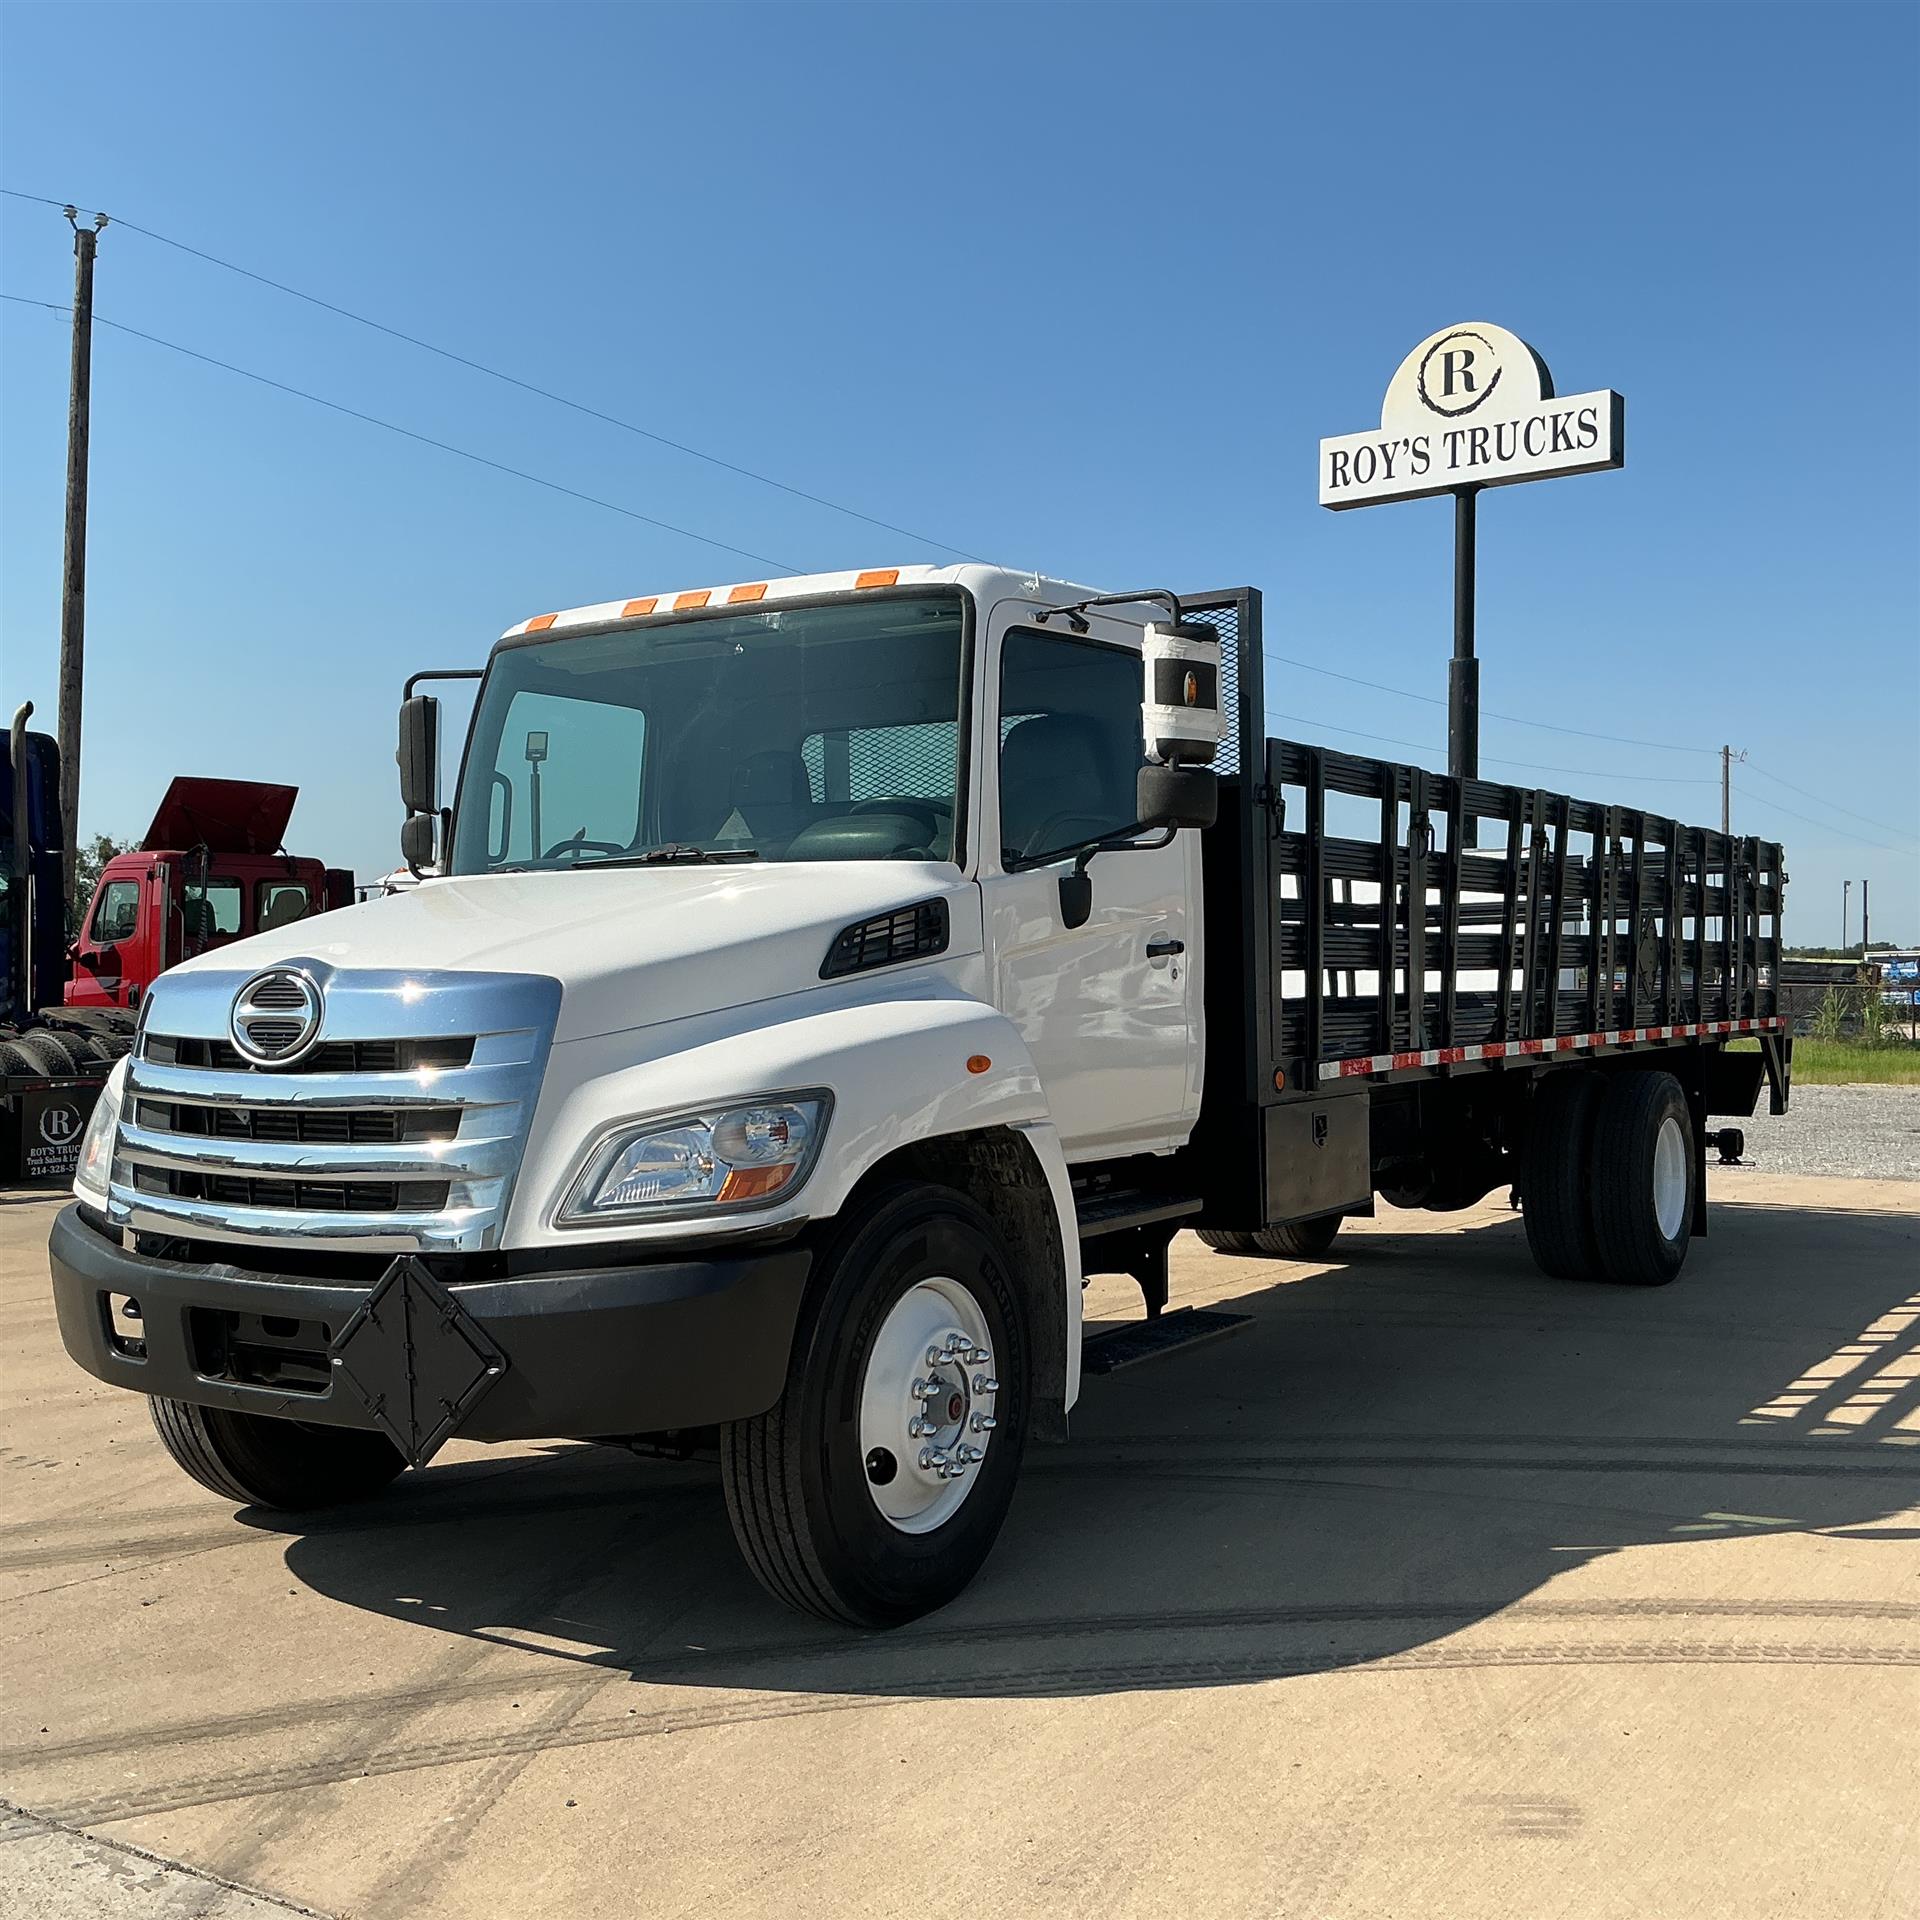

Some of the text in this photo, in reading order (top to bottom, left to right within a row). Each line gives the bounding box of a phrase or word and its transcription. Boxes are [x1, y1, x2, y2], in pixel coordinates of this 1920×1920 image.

[1440, 349, 1479, 397] R
[1329, 408, 1598, 489] ROY'S TRUCKS
[49, 1110, 71, 1135] R
[30, 1145, 80, 1157] ROY'S TRUC
[45, 1156, 62, 1165] Sales
[63, 1155, 69, 1163] &
[31, 1164, 77, 1175] 214-328-5
